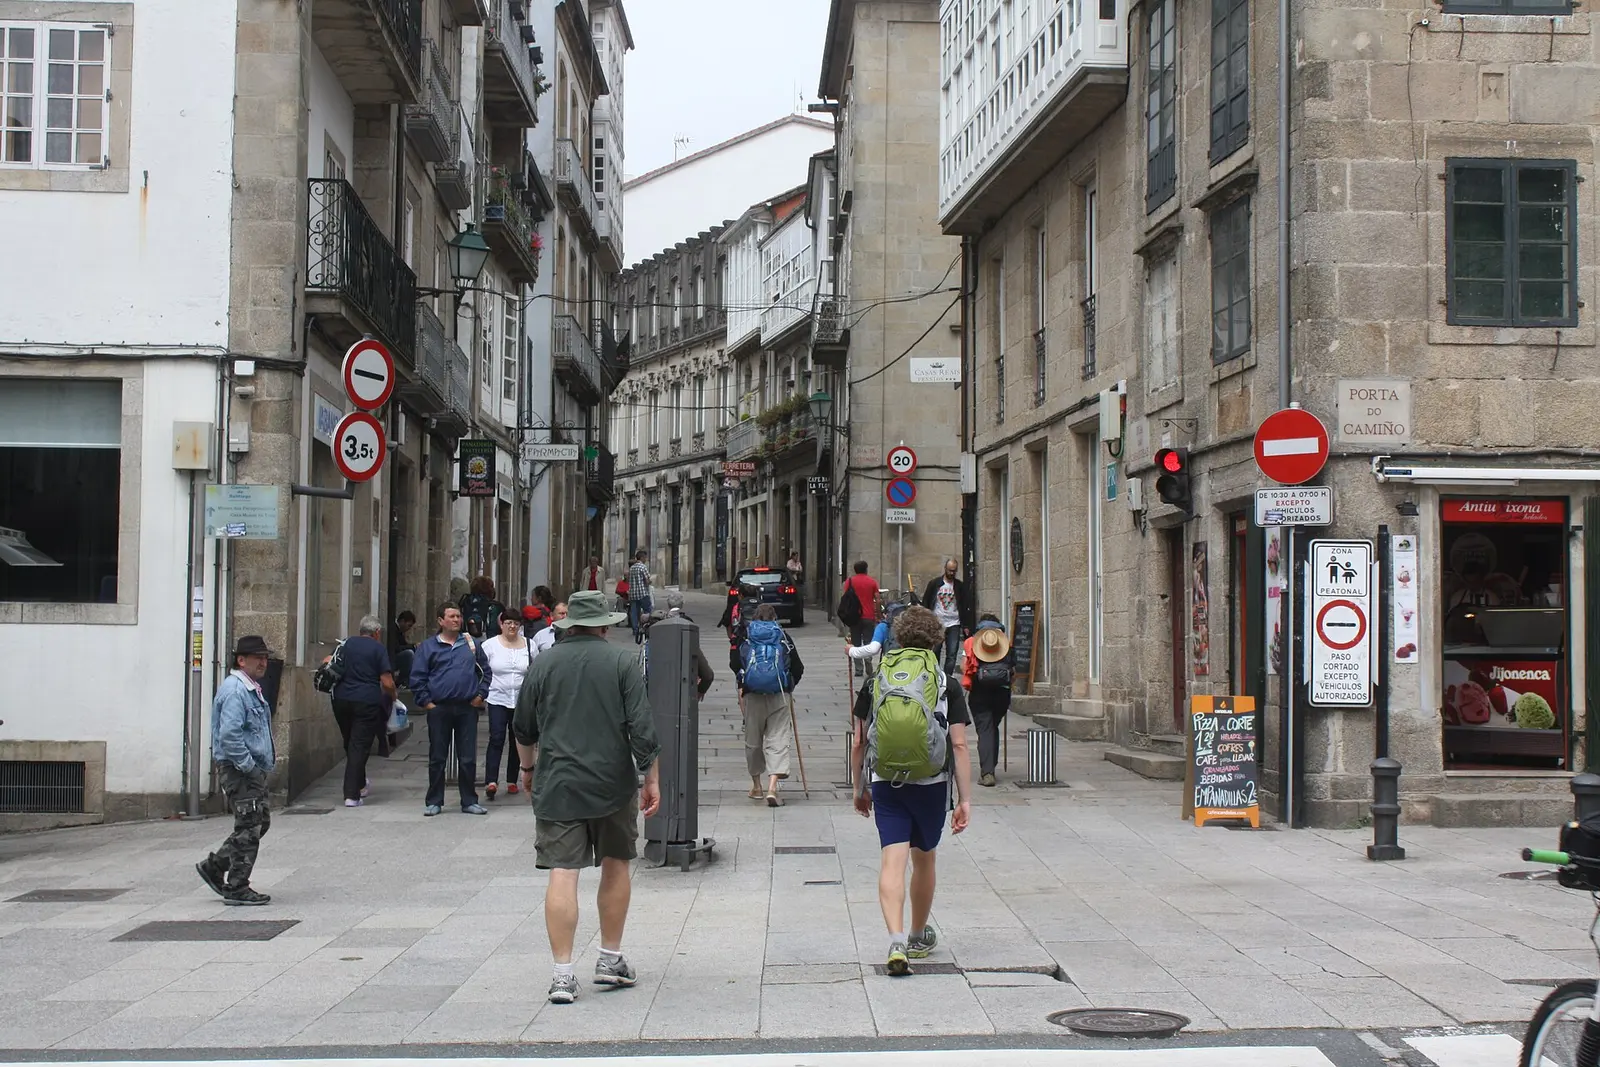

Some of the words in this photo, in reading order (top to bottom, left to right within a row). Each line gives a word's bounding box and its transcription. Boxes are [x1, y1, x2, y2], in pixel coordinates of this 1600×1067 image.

[1349, 388, 1399, 400] PORTA
[1367, 407, 1381, 416] DO
[1343, 421, 1405, 435] CAMIÑO
[527, 447, 577, 457] FARMACIA
[893, 455, 910, 466] 20
[1275, 499, 1311, 507] EXCEPTO
[1458, 501, 1497, 512] Antiu
[1282, 514, 1322, 523] ORIZADOS
[1323, 662, 1359, 671] CORTADO
[1323, 672, 1359, 680] EXCEPTO
[1489, 665, 1551, 682] Jijonenca
[1320, 682, 1362, 690] VEHICULOS
[1314, 692, 1368, 700] AUTORIZADOS
[1226, 715, 1255, 731] CORTE
[1217, 742, 1244, 755] GOFRES
[1196, 754, 1218, 766] CAFE
[1232, 753, 1254, 762] LLEVAR
[1199, 773, 1233, 785] BEBIDAS
[1195, 785, 1247, 808] EMPANADILLAS
